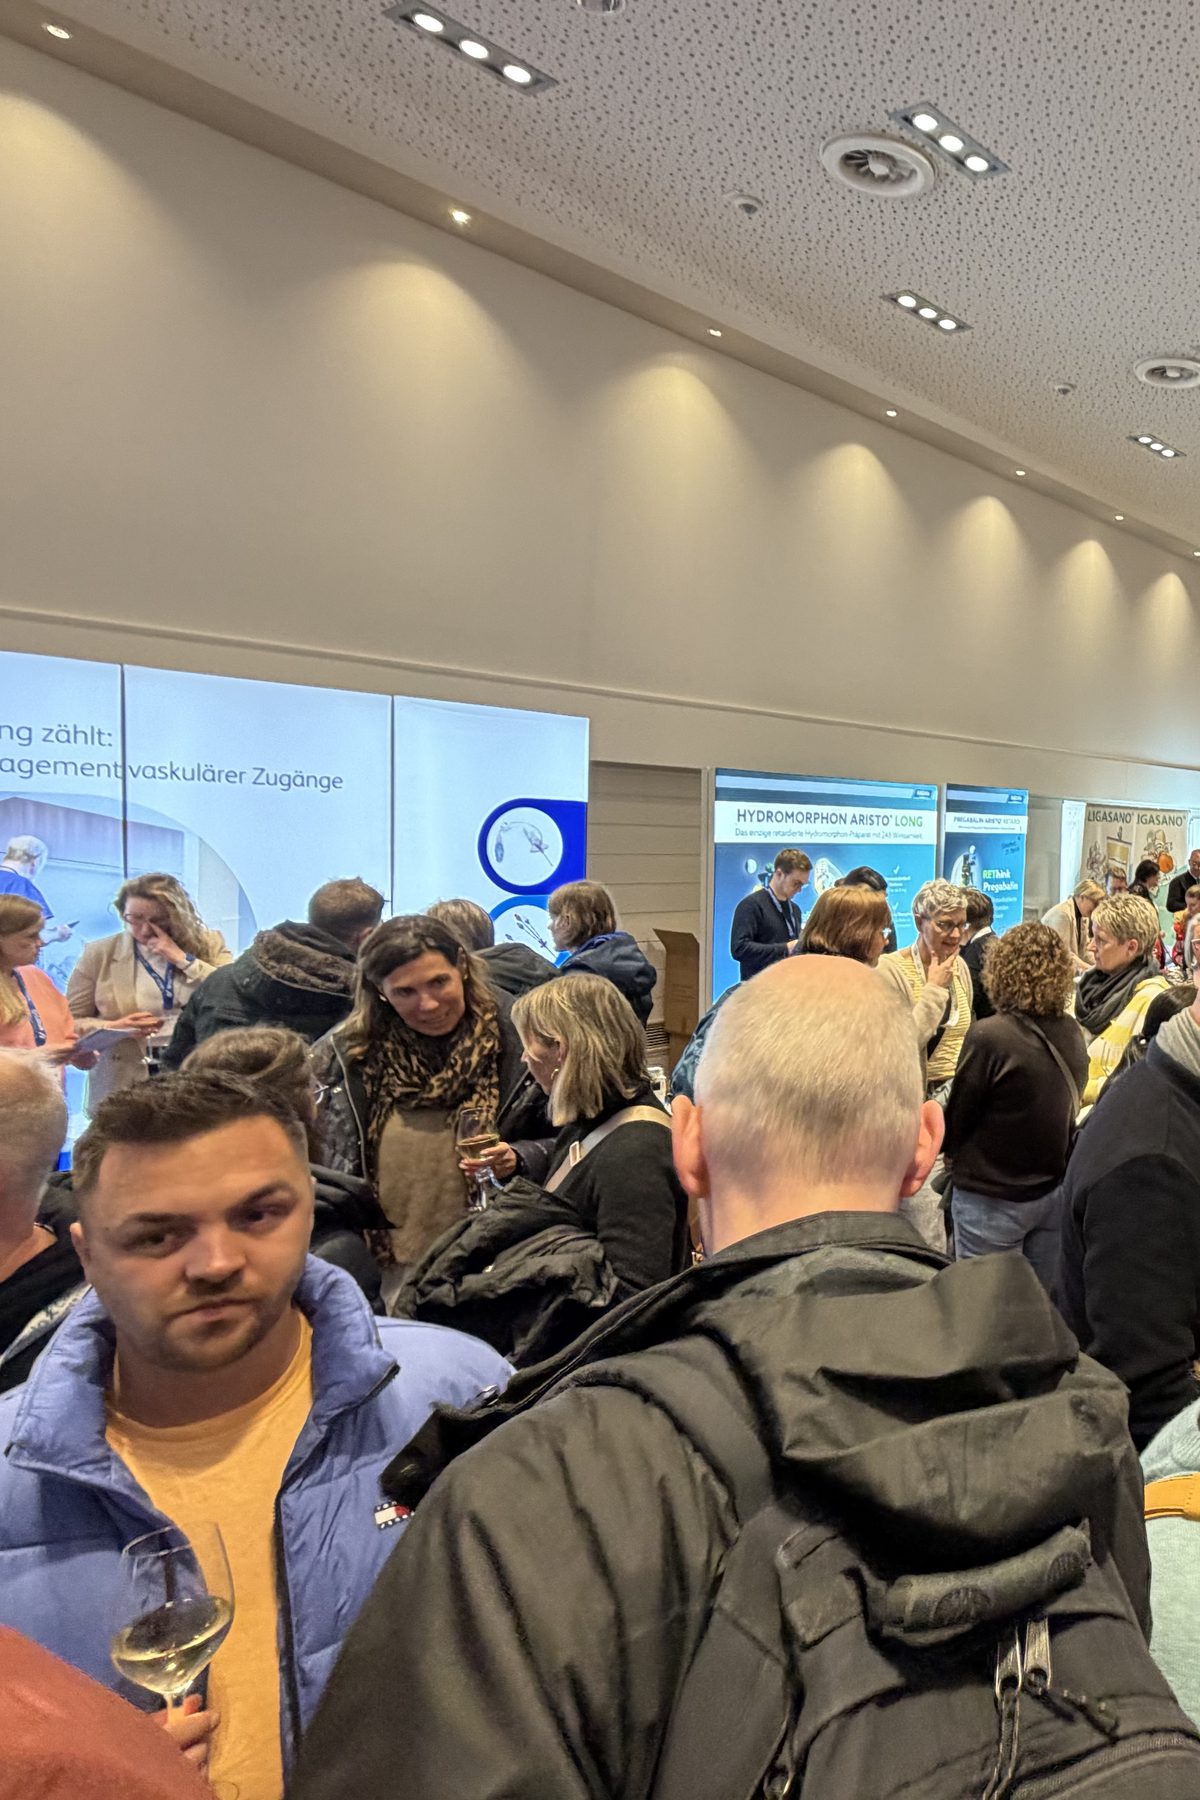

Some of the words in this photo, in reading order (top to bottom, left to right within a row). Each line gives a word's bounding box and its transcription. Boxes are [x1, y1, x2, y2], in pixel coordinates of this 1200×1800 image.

[41, 724, 113, 747] zählt:
[128, 760, 247, 784] vaskulärer
[251, 767, 343, 793] Zugänge
[737, 808, 847, 825] HYDROMORPHON
[895, 815, 923, 827] LONG
[983, 881, 1019, 893] Pregabalin
